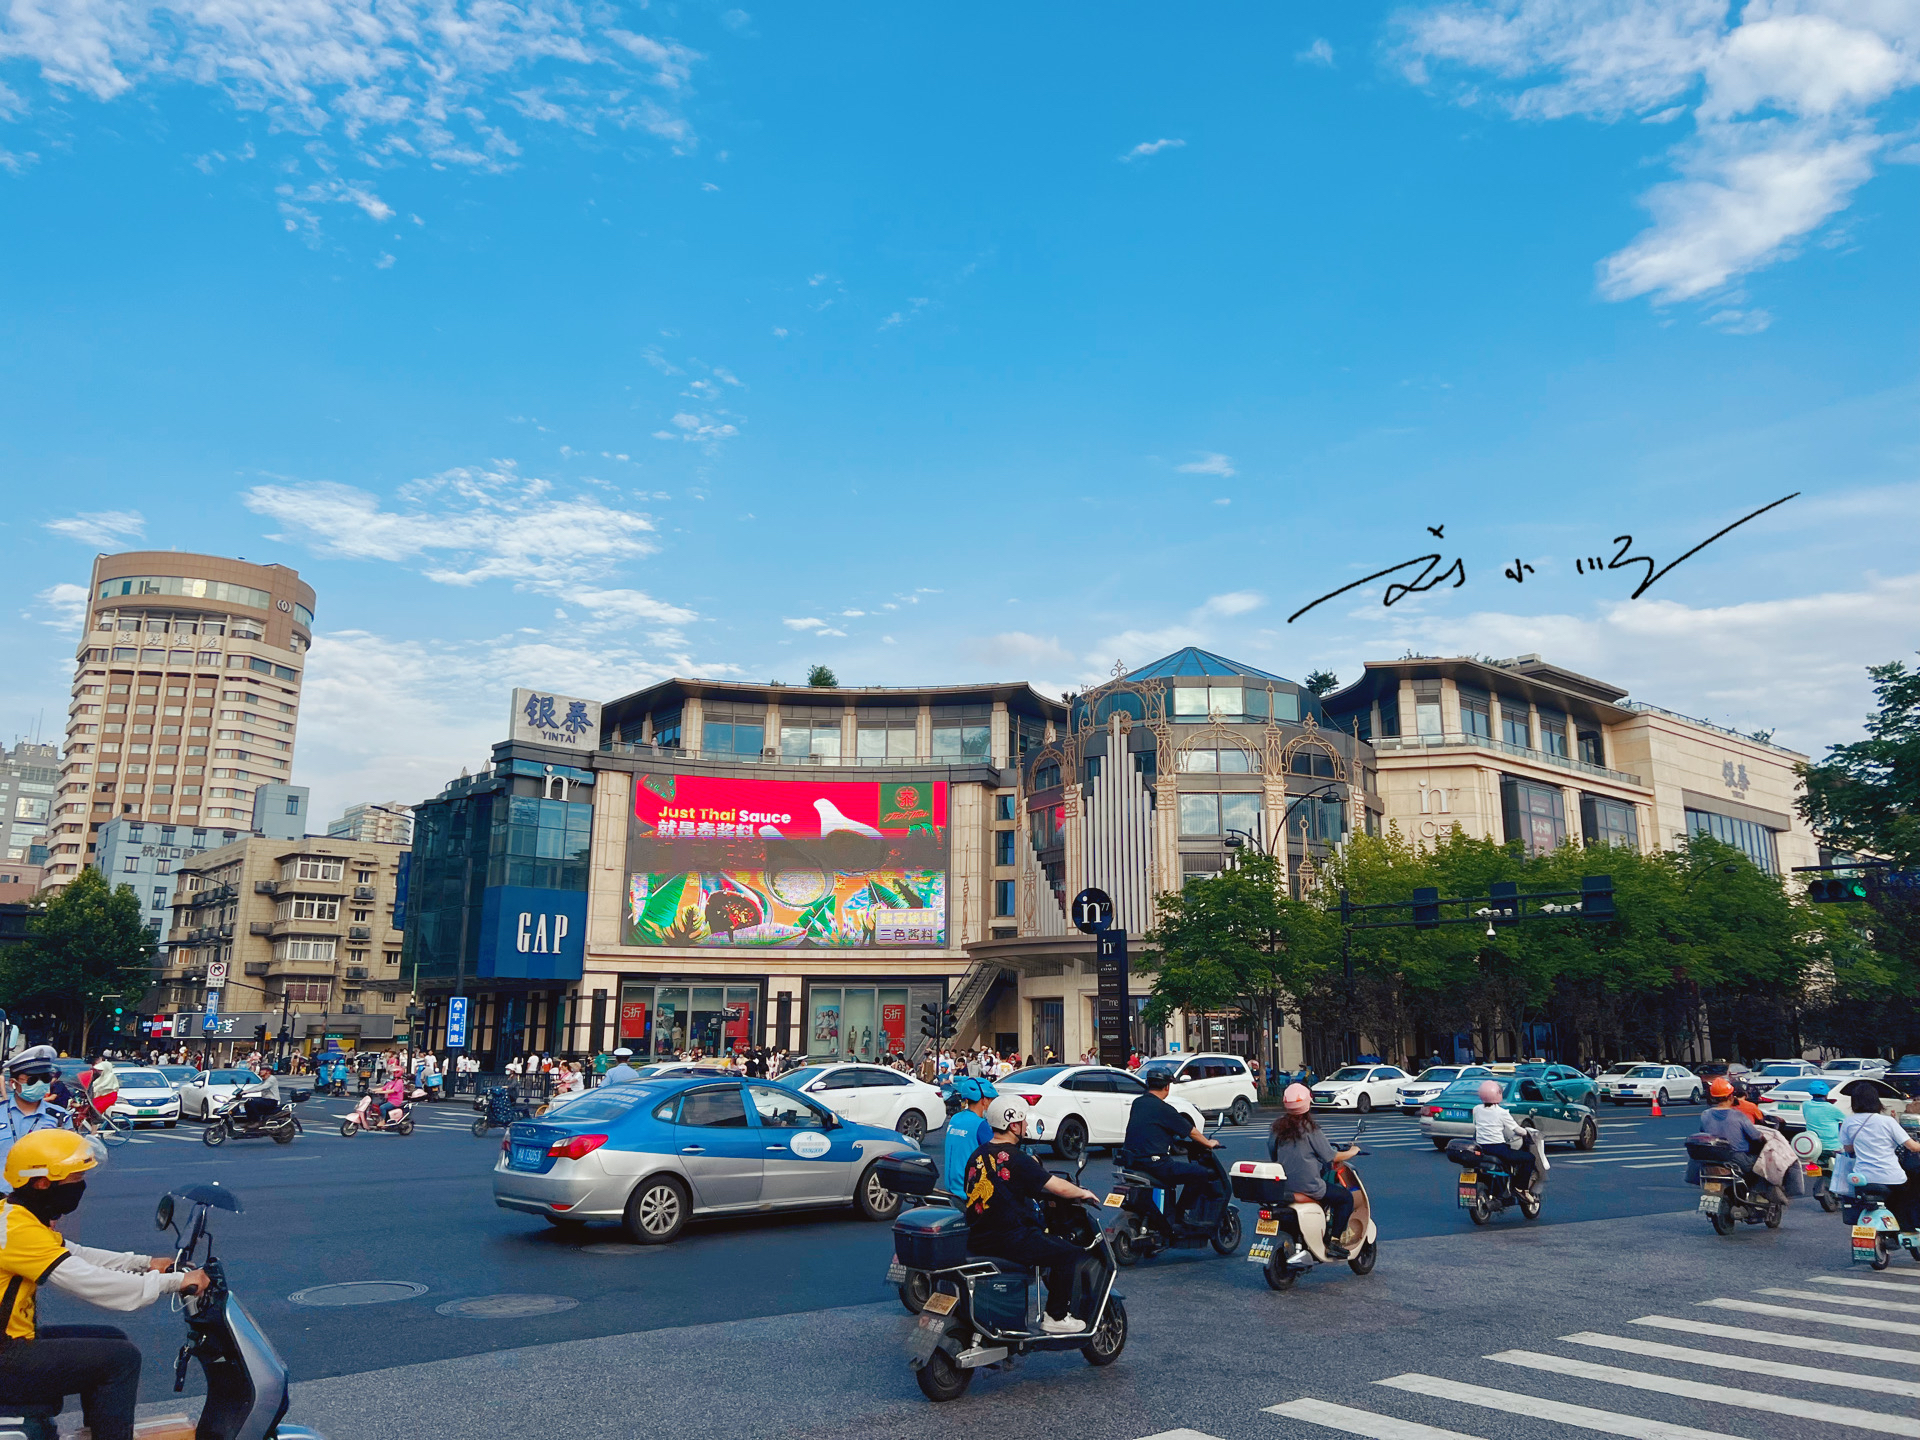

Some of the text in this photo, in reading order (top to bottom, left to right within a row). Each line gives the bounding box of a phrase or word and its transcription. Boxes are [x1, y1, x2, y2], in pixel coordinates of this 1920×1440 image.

[524, 693, 594, 734] 银泰
[542, 731, 576, 744] YINTAI
[658, 806, 791, 824] Just Thai Sauce
[141, 844, 208, 859] 杭州口腔
[516, 912, 569, 954] GAP
[880, 928, 934, 941] 三色酱料
[623, 1006, 641, 1018] 5折
[884, 1008, 901, 1020] 5折
[450, 1012, 460, 1043] 平海路
